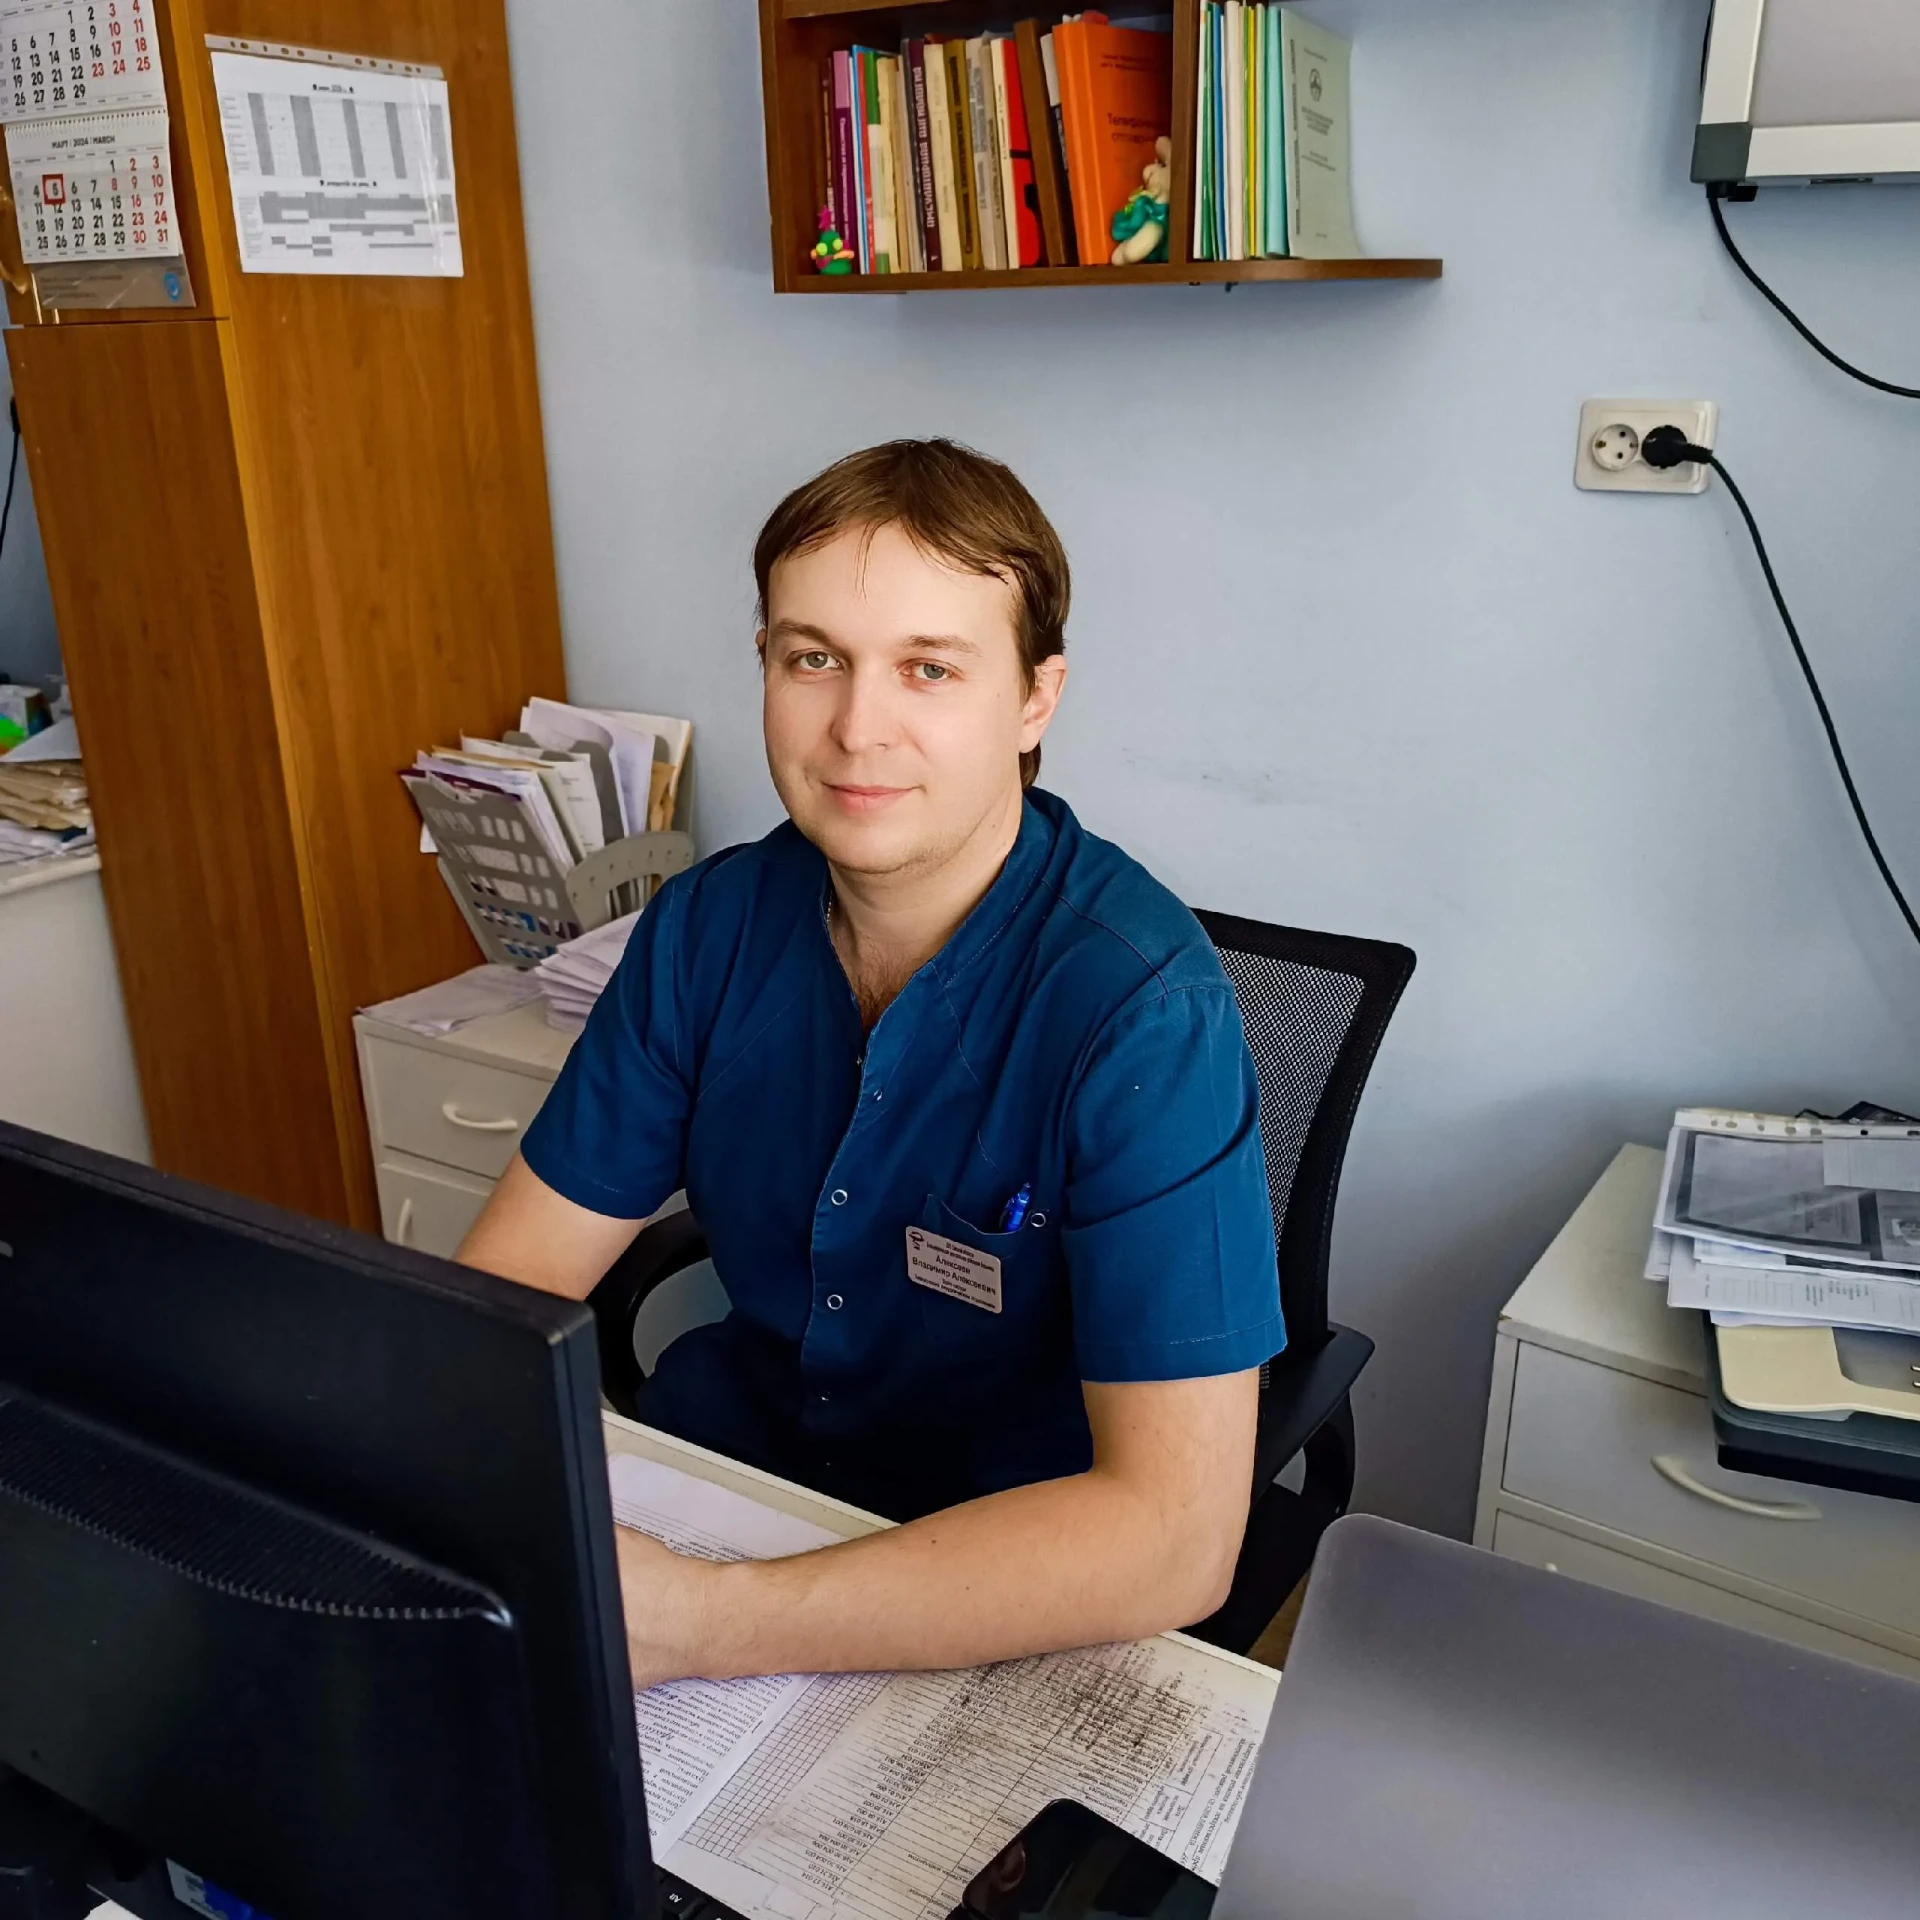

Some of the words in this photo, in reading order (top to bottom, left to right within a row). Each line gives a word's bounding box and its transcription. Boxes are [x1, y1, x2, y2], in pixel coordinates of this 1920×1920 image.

[68, 11, 73, 23] 1
[88, 6, 94, 20] 2
[109, 3, 116, 17] 3
[133, 0, 140, 13] 4
[12, 39, 17, 52] 5
[30, 36, 36, 48] 6
[49, 33, 55, 46] 7
[70, 29, 76, 43] 8
[90, 26, 96, 39] 9
[109, 22, 120, 36] 10
[134, 19, 144, 32] 11
[12, 57, 21, 71] 12
[30, 54, 41, 68] 13
[49, 51, 60, 64] 14
[70, 48, 80, 61] 15
[90, 44, 101, 58] 16
[112, 41, 122, 55] 17
[135, 37, 147, 52] 18
[14, 74, 23, 88] 19
[31, 71, 44, 86] 20
[52, 69, 62, 83] 21
[71, 65, 84, 80] 22
[92, 63, 104, 77] 23
[113, 60, 125, 74] 24
[137, 56, 150, 71] 25
[14, 93, 26, 107] 26
[34, 90, 45, 103] 27
[53, 87, 65, 101] 28
[74, 84, 86, 99] 29
[52, 138, 68, 149] МАРТ
[73, 135, 89, 147] 2024
[93, 135, 115, 146] MARCH
[110, 160, 115, 173] 1
[130, 158, 137, 172] 2
[153, 155, 159, 169] 3
[33, 185, 40, 198] 4
[53, 182, 58, 196] 5
[71, 181, 77, 195] 6
[91, 180, 97, 193] 7
[111, 178, 118, 191] 8
[131, 175, 138, 189] 9
[152, 174, 163, 187] 10
[34, 202, 43, 215] 11
[54, 203, 63, 214] 12
[71, 199, 81, 213] 13
[90, 197, 102, 211] 14
[111, 196, 122, 209] 15
[131, 194, 142, 208] 16
[154, 192, 164, 206] 17
[36, 219, 46, 233] 18
[55, 217, 64, 232] 19
[72, 216, 84, 230] 20
[93, 215, 103, 229] 21
[112, 213, 124, 227] 22
[132, 212, 145, 226] 23
[155, 211, 167, 225] 24
[37, 236, 48, 249] 25
[56, 234, 67, 248] 26
[74, 233, 85, 247] 27
[94, 232, 106, 246] 28
[114, 231, 125, 245] 29
[133, 230, 146, 244] 30
[157, 228, 168, 242] 31
[912, 1257, 950, 1278] Владимир
[951, 1272, 996, 1295] Алексеевич
[935, 1255, 971, 1274] Алексеев
